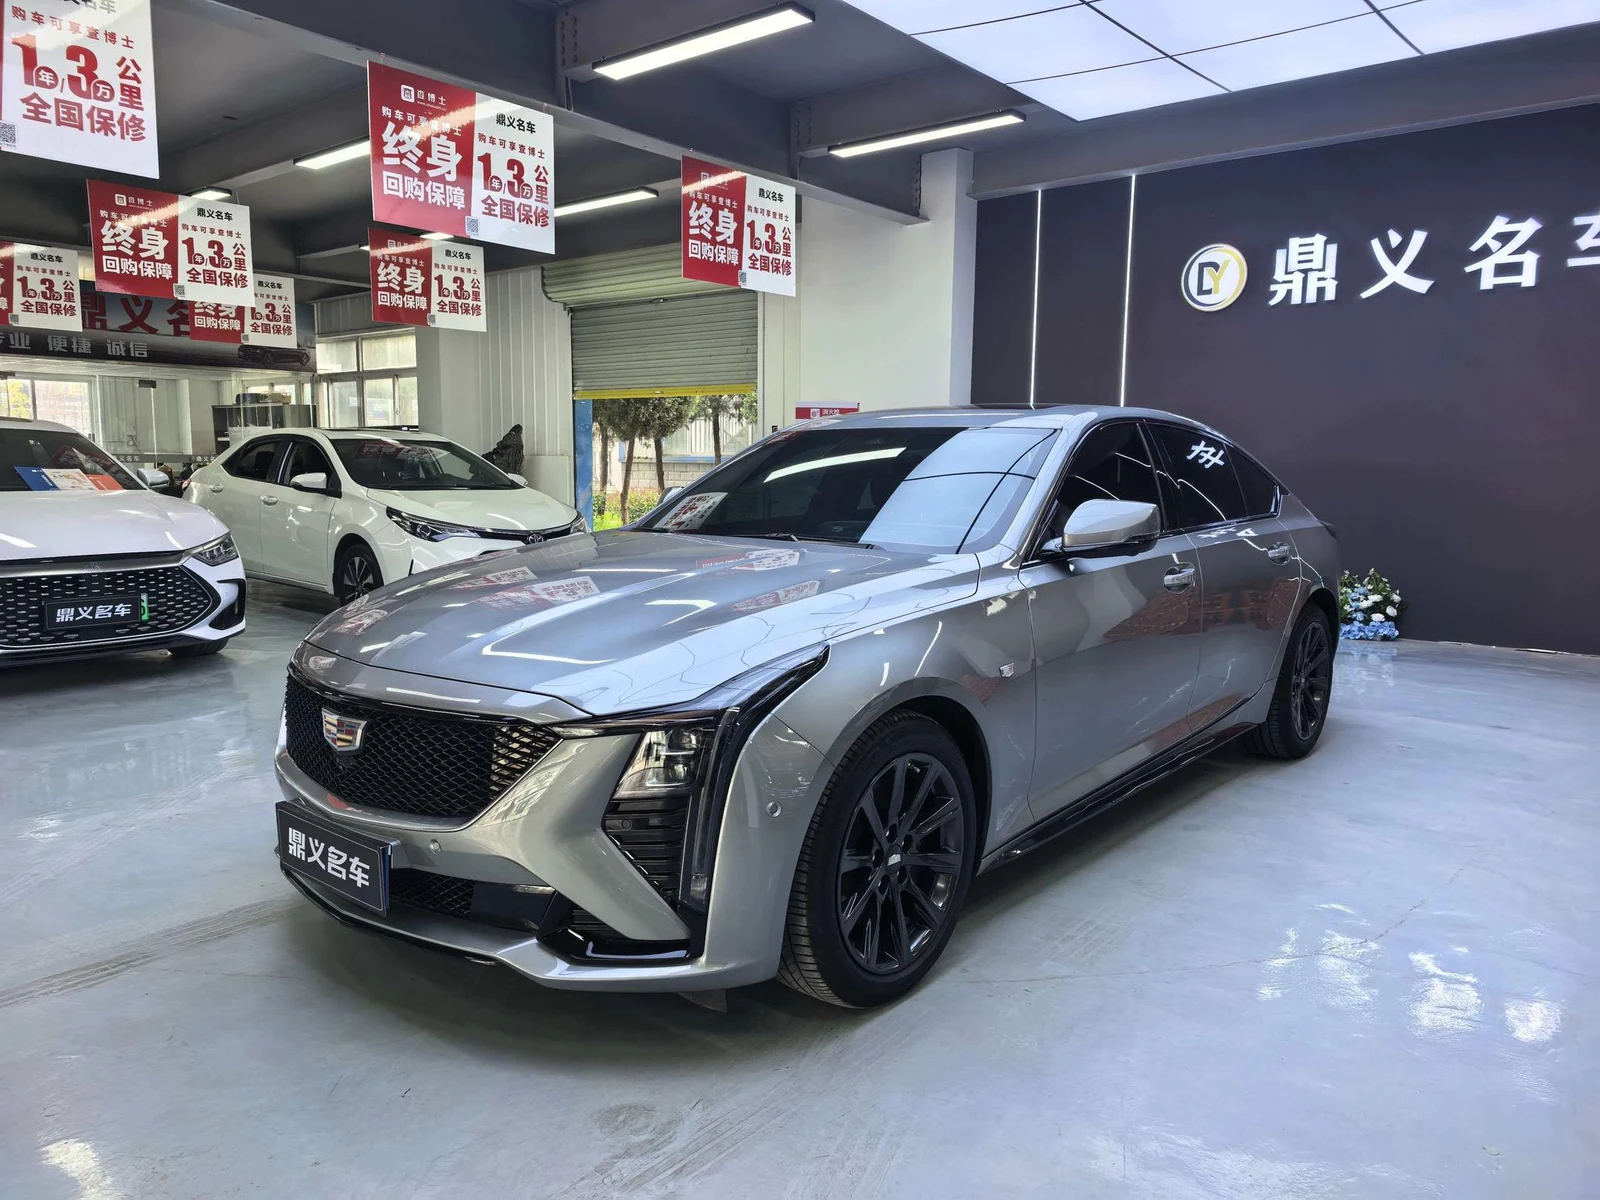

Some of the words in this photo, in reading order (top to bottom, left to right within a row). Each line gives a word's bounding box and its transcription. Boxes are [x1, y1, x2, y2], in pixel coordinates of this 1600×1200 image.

[11, 5, 134, 49] 购车可享查博士
[19, 91, 146, 142] 全国保修
[496, 113, 536, 134] 鼎义名车
[382, 121, 463, 183] 终身
[478, 132, 545, 160] 购车可享查博士
[382, 171, 465, 210] 回购保障
[759, 187, 784, 203] 鼎义名车
[196, 207, 233, 222] 鼎义名车
[482, 195, 549, 228] 全国保修
[688, 200, 738, 245] 终身
[101, 220, 169, 261] 终身
[182, 223, 242, 239] 购车可享查博士
[688, 239, 739, 267] 回购保障
[748, 253, 792, 276] 全国保修
[102, 256, 173, 280] 回购保障
[186, 267, 249, 289] 全国保修
[377, 261, 425, 294] 终身
[20, 300, 77, 317] 全国保修
[378, 291, 427, 311] 回购保障
[437, 300, 482, 316] 全国保修
[194, 316, 241, 331] 回购保障
[250, 322, 293, 336] 全国保修
[47, 334, 92, 354] 便捷
[106, 339, 148, 358] 诚信
[56, 603, 132, 623] 鼎义名车
[288, 826, 370, 888] 鼎义名车
